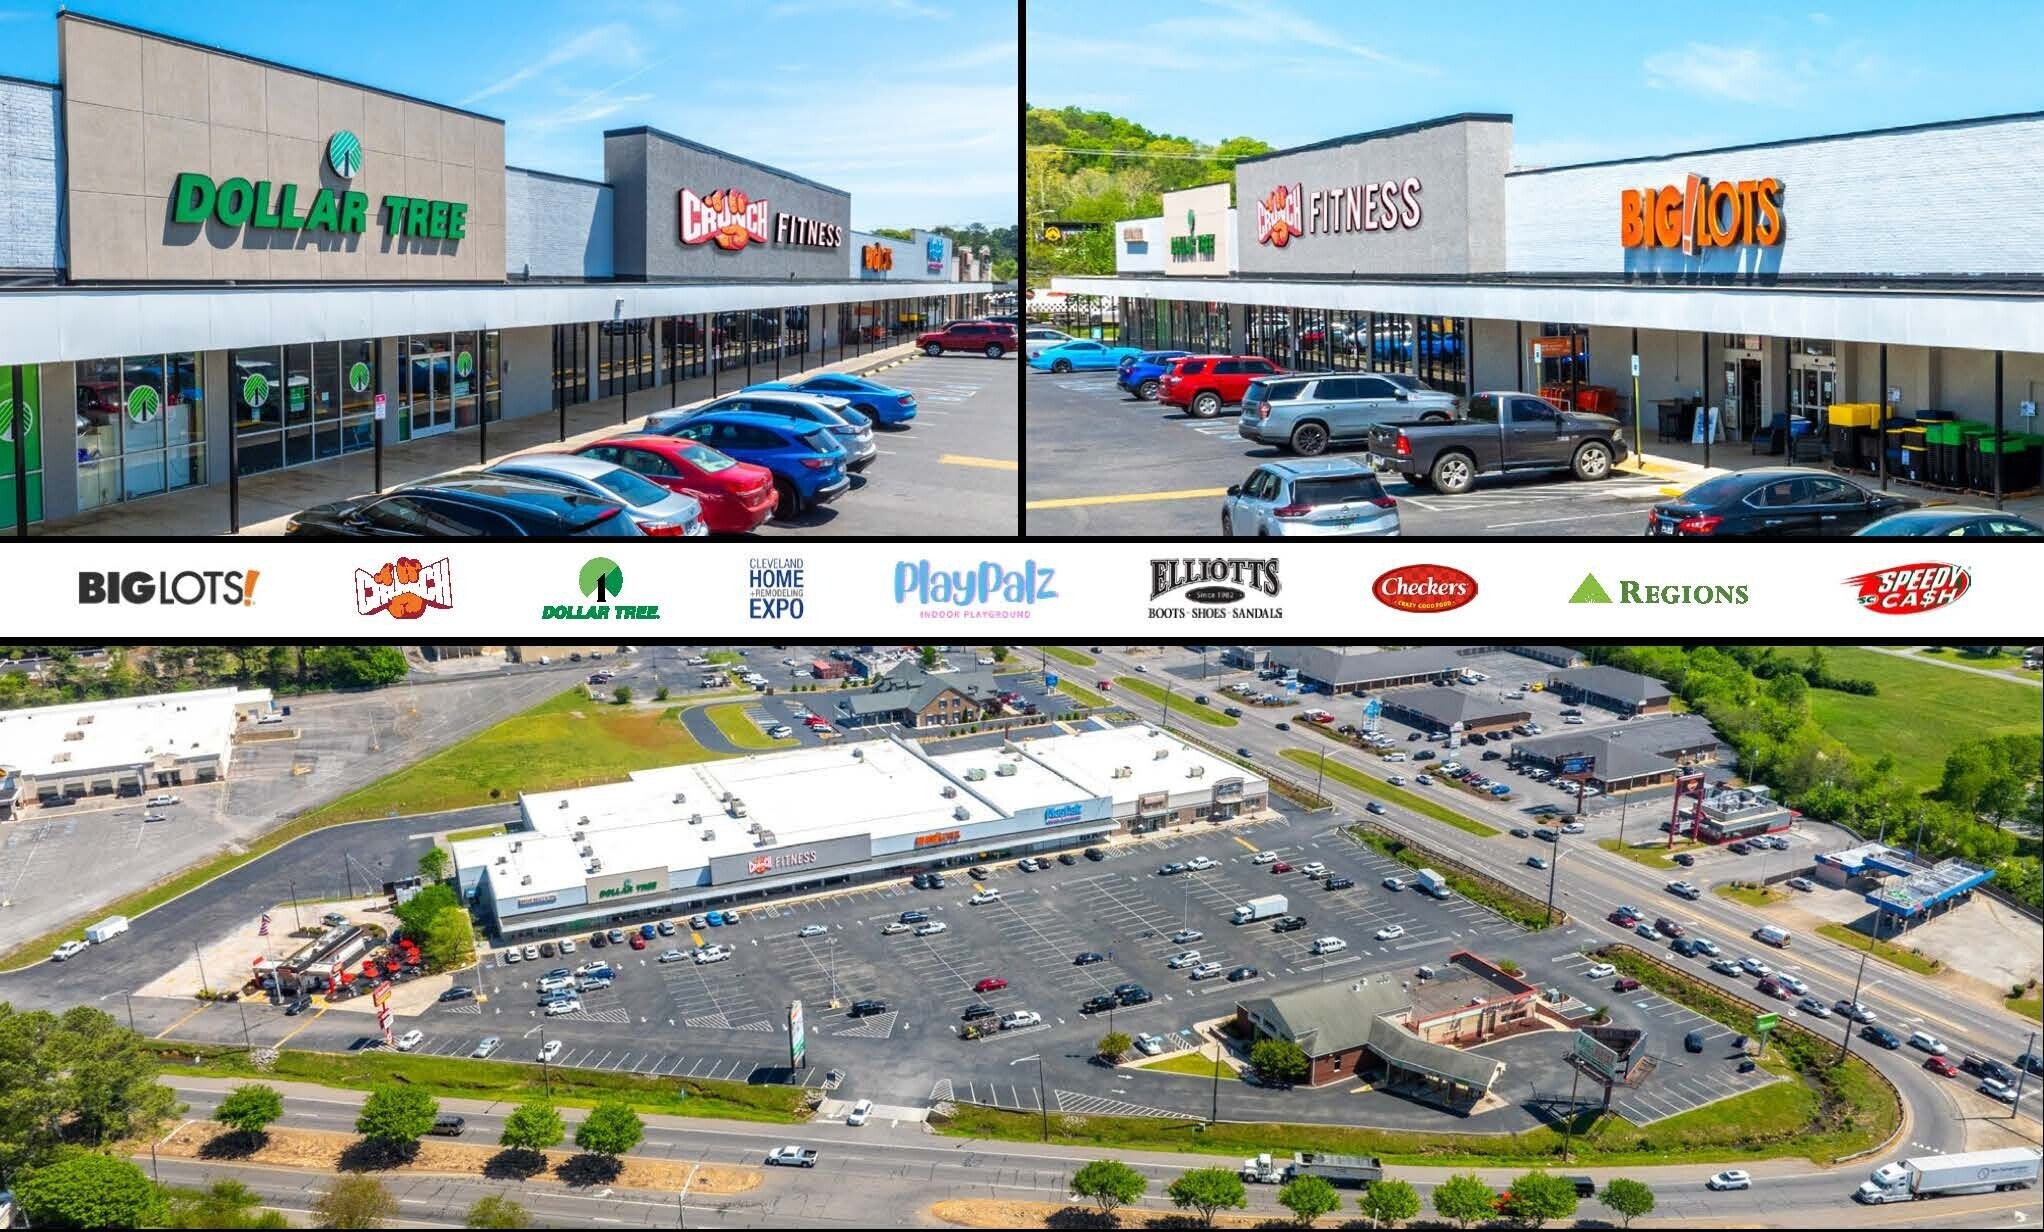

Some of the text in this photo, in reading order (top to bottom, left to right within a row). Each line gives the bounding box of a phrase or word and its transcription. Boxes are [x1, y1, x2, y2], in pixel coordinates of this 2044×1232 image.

[173, 172, 469, 240] DOLLAR TREE
[1310, 177, 1422, 233] FITNESS
[775, 212, 842, 247] FITNESS
[775, 850, 817, 867] FITNESS
